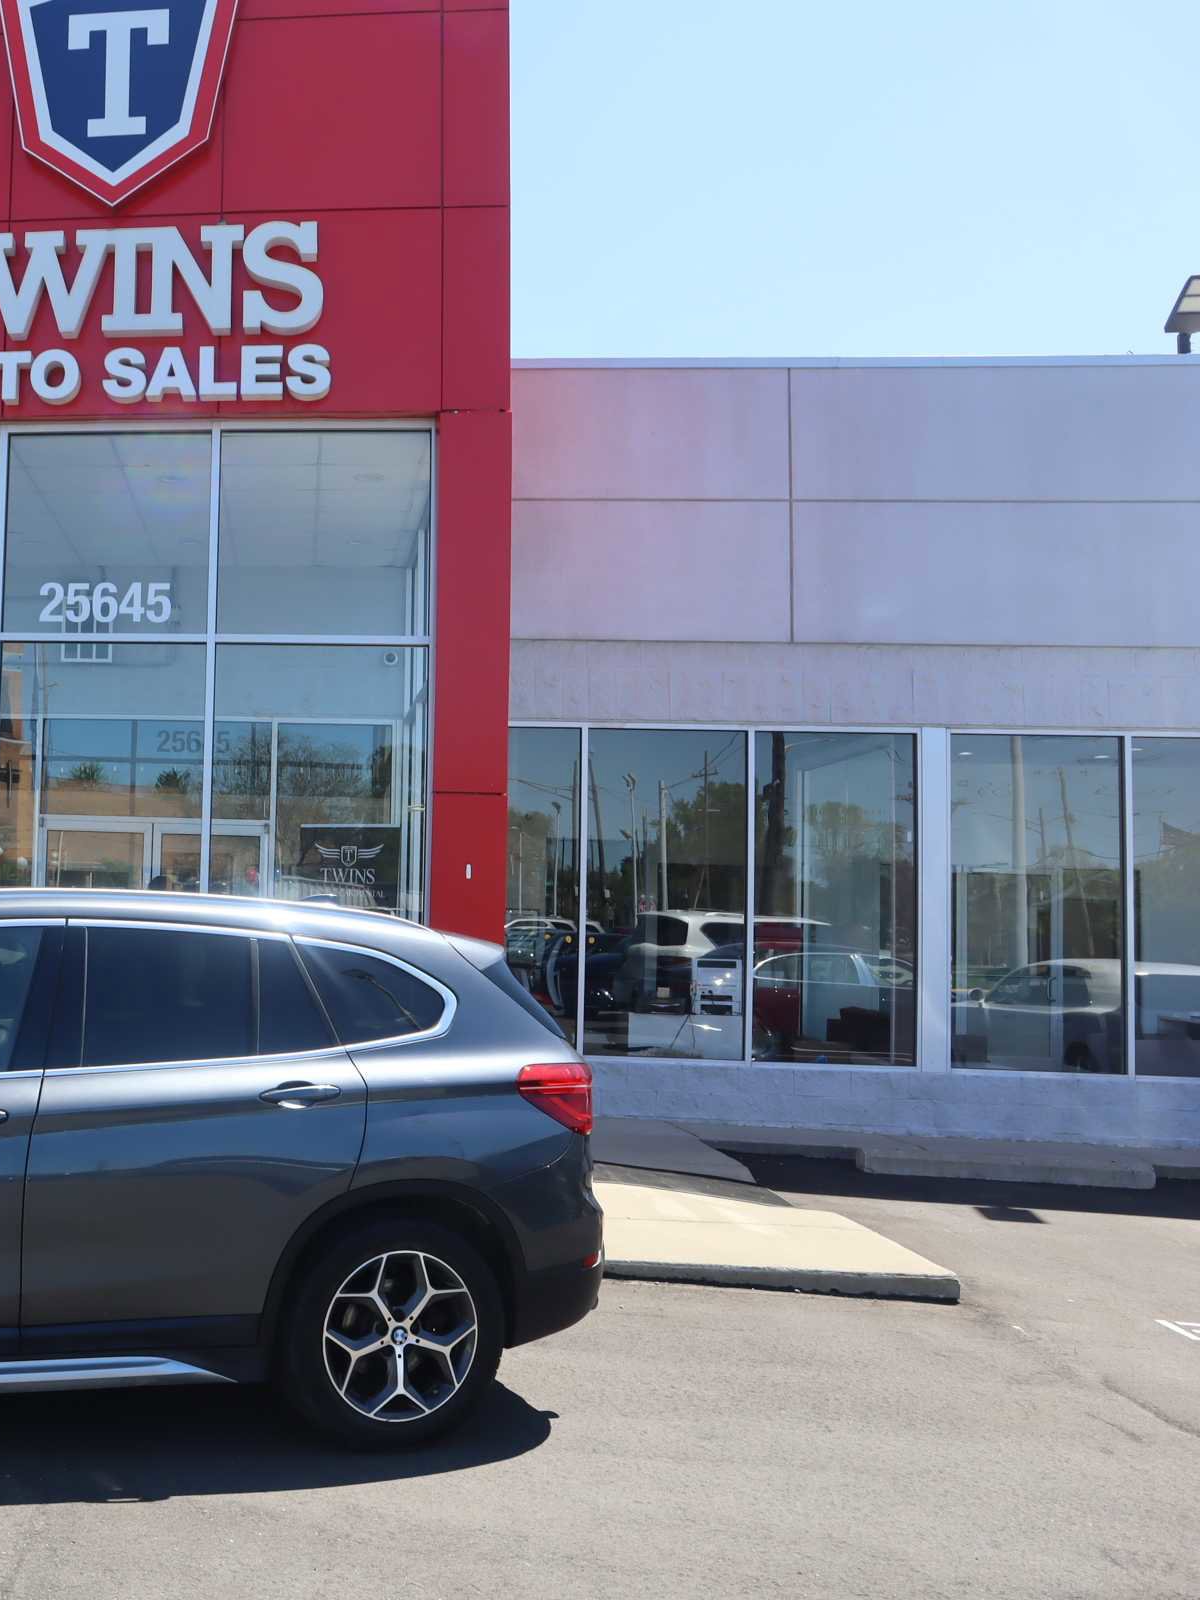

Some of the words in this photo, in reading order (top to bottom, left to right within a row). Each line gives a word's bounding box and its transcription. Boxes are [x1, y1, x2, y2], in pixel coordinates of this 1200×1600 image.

[67, 8, 170, 138] T
[102, 343, 332, 405] SALES
[38, 581, 172, 624] 25645
[156, 730, 231, 754] 2565
[320, 867, 376, 885] TWINS
